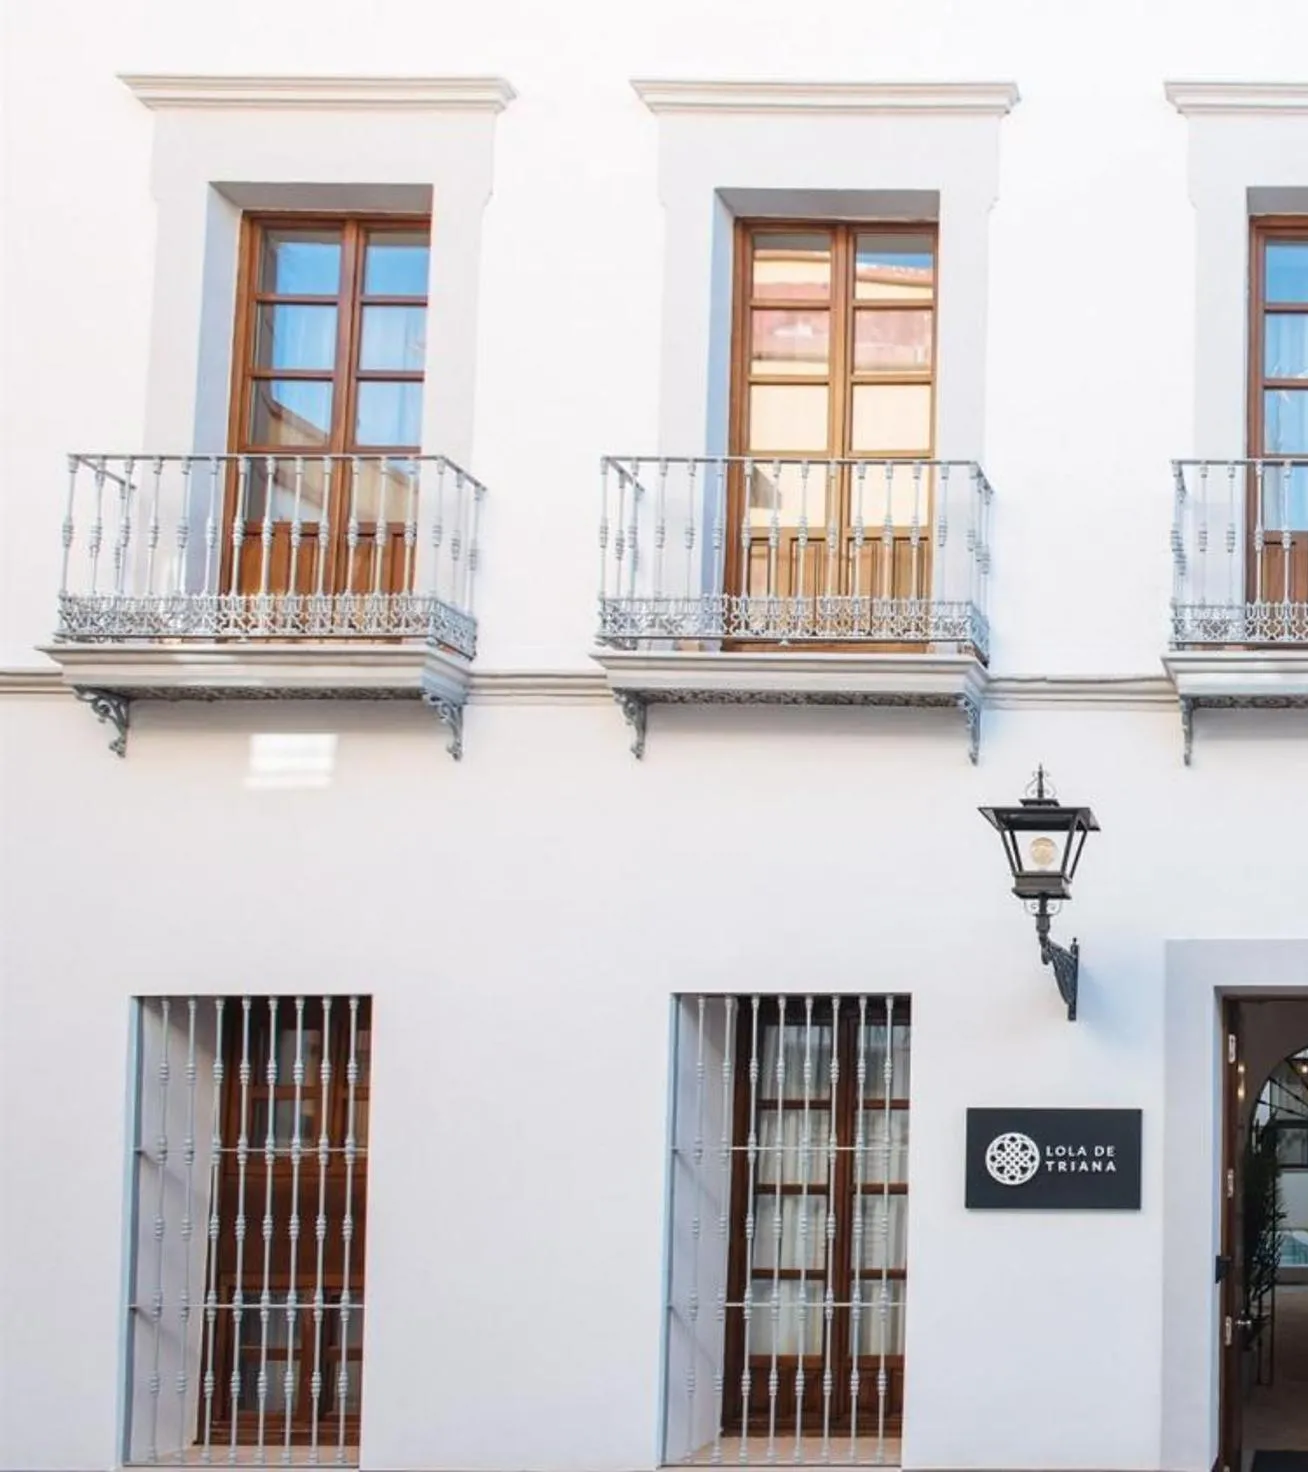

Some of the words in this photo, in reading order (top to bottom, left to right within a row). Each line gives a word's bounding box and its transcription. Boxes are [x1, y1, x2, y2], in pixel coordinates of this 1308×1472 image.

[1045, 1145, 1087, 1157] LOLA
[1094, 1145, 1116, 1157] DE
[1045, 1160, 1117, 1172] TRIANA
